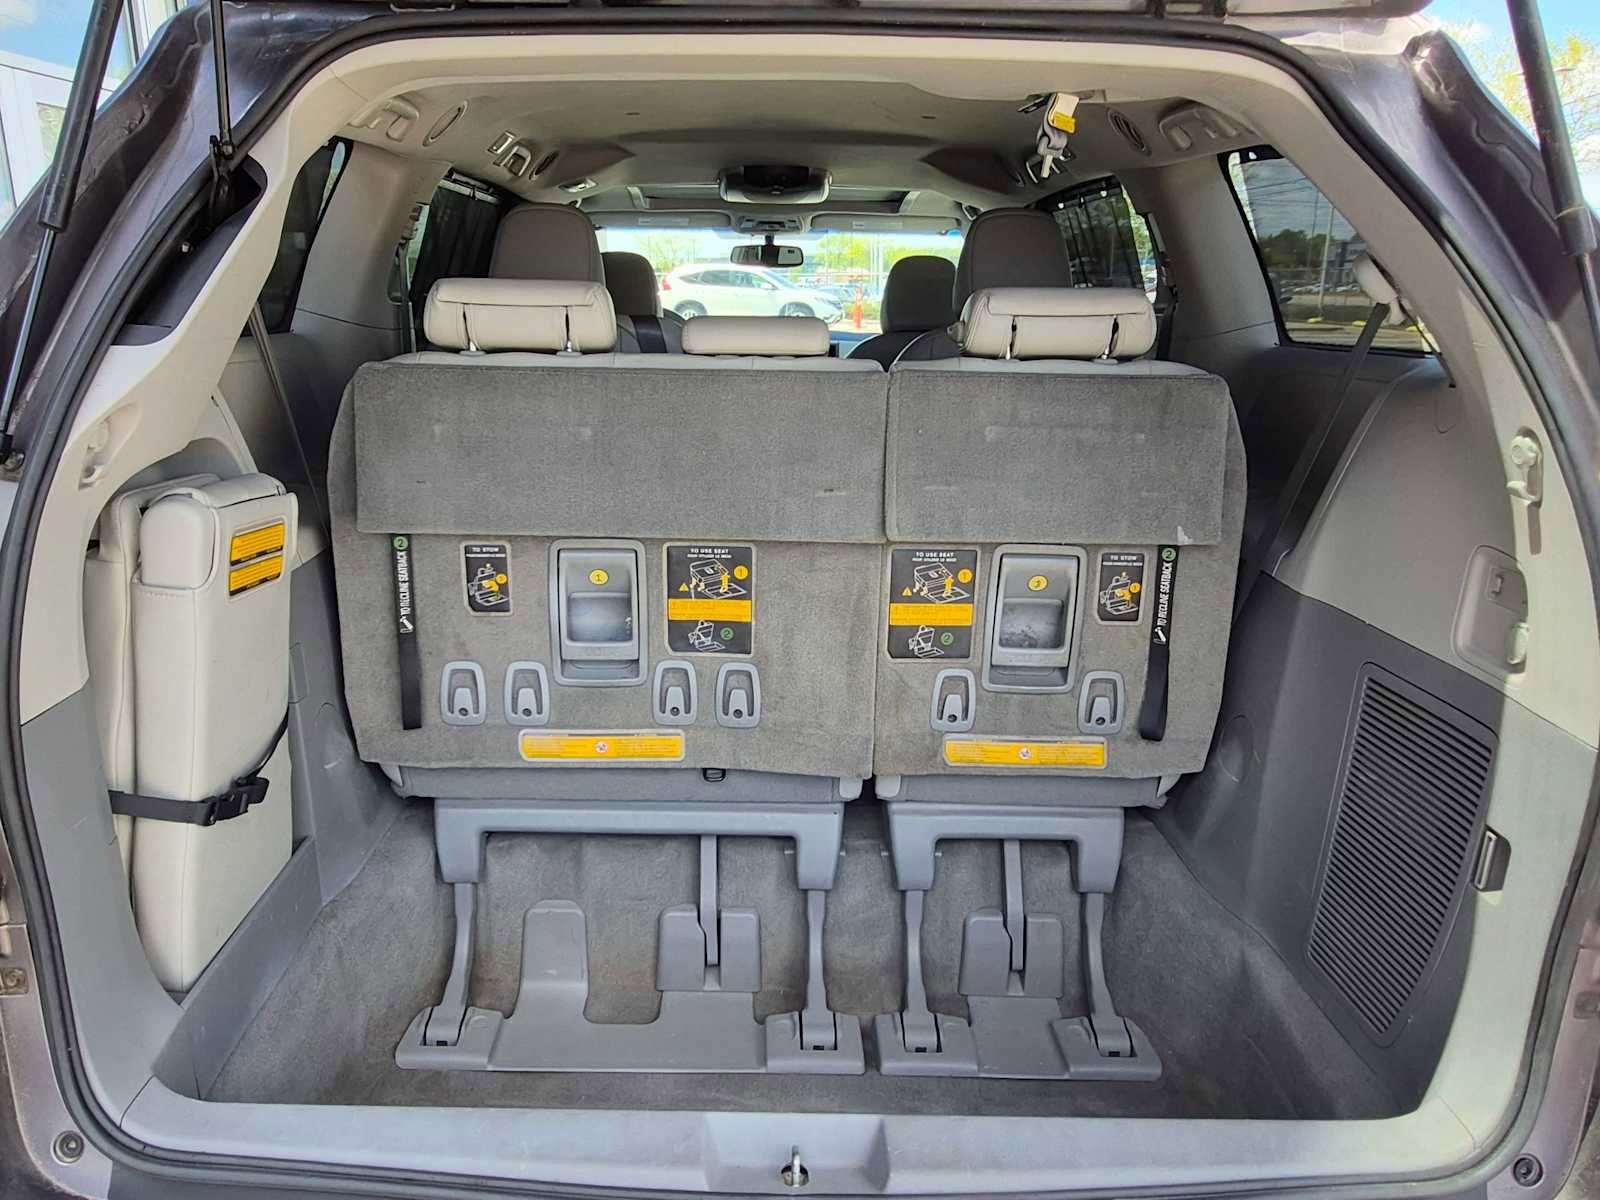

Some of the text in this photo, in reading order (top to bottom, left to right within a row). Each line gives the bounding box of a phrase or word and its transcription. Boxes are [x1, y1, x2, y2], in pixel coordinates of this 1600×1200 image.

[397, 551, 409, 581] SEATBACK
[1160, 562, 1173, 592] SEATBACK
[399, 583, 410, 607] RECLINE
[1158, 593, 1169, 618] RECLINE
